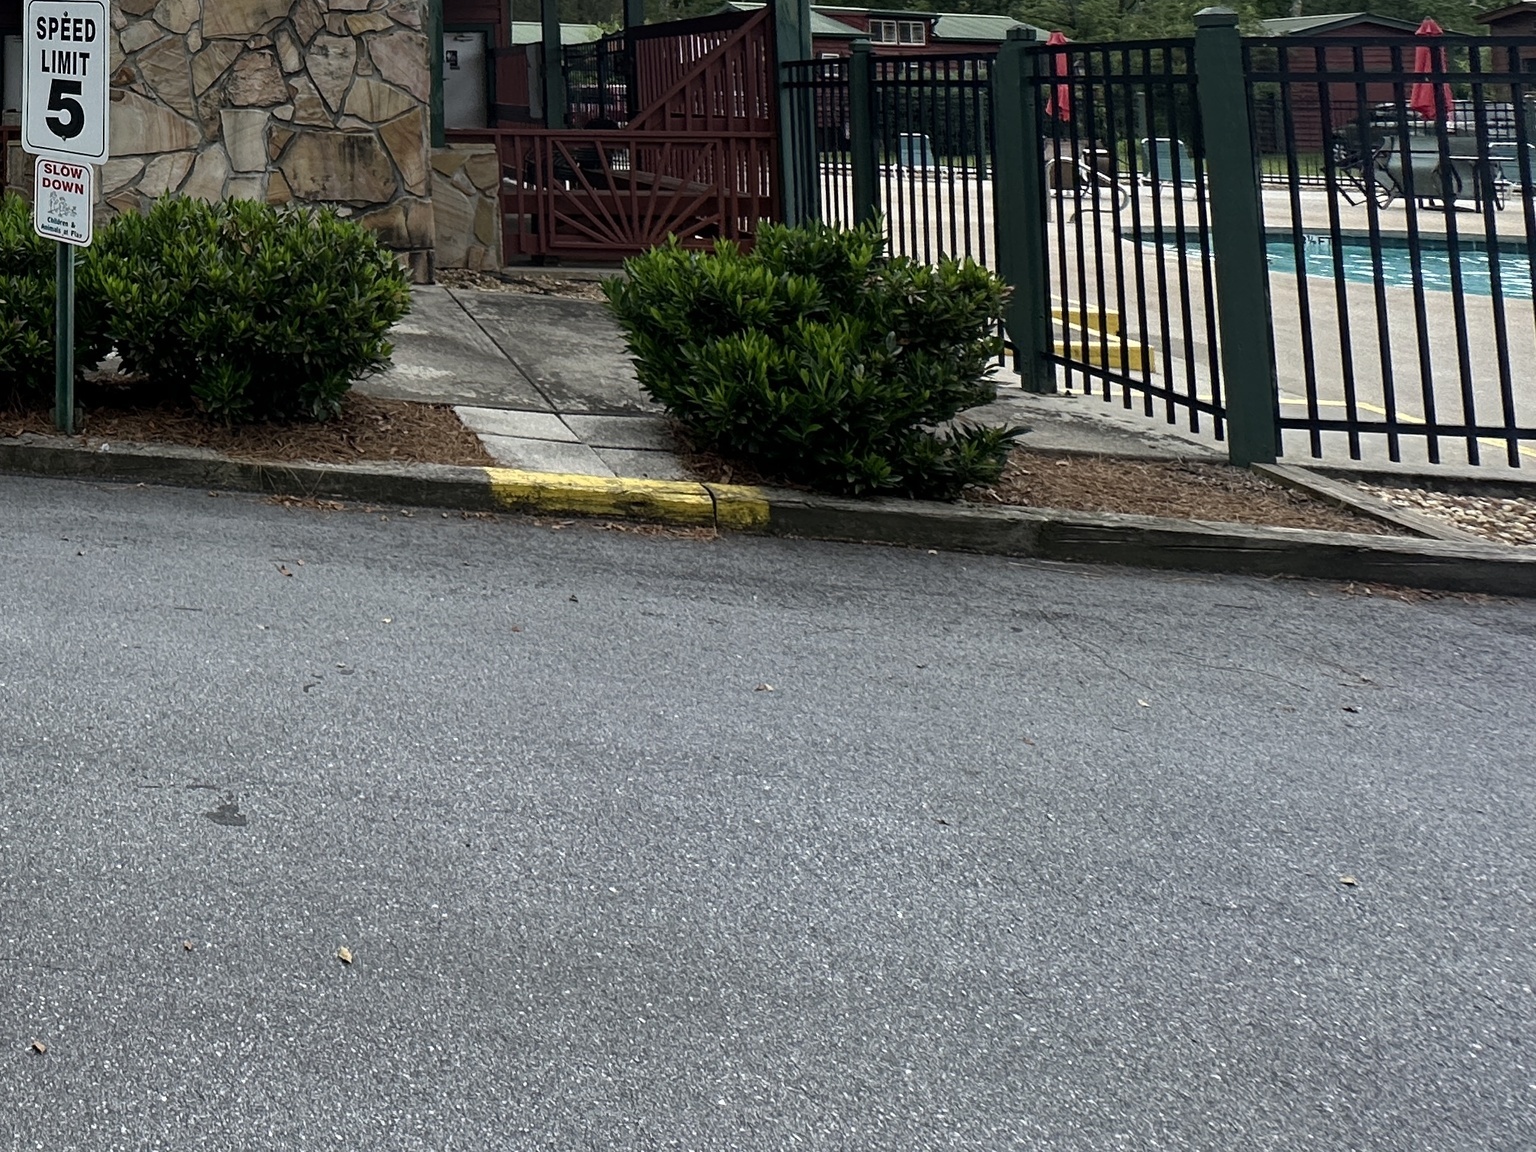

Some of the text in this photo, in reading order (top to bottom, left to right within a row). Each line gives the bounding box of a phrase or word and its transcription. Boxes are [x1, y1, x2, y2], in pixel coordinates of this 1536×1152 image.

[36, 16, 96, 43] SPEED
[41, 49, 90, 76] LIMIT
[45, 78, 85, 139] 5
[44, 163, 83, 179] SLOW
[42, 177, 84, 195] DOWN
[41, 223, 61, 234] Animals
[70, 230, 83, 239] Play
[47, 216, 76, 229] Children &
